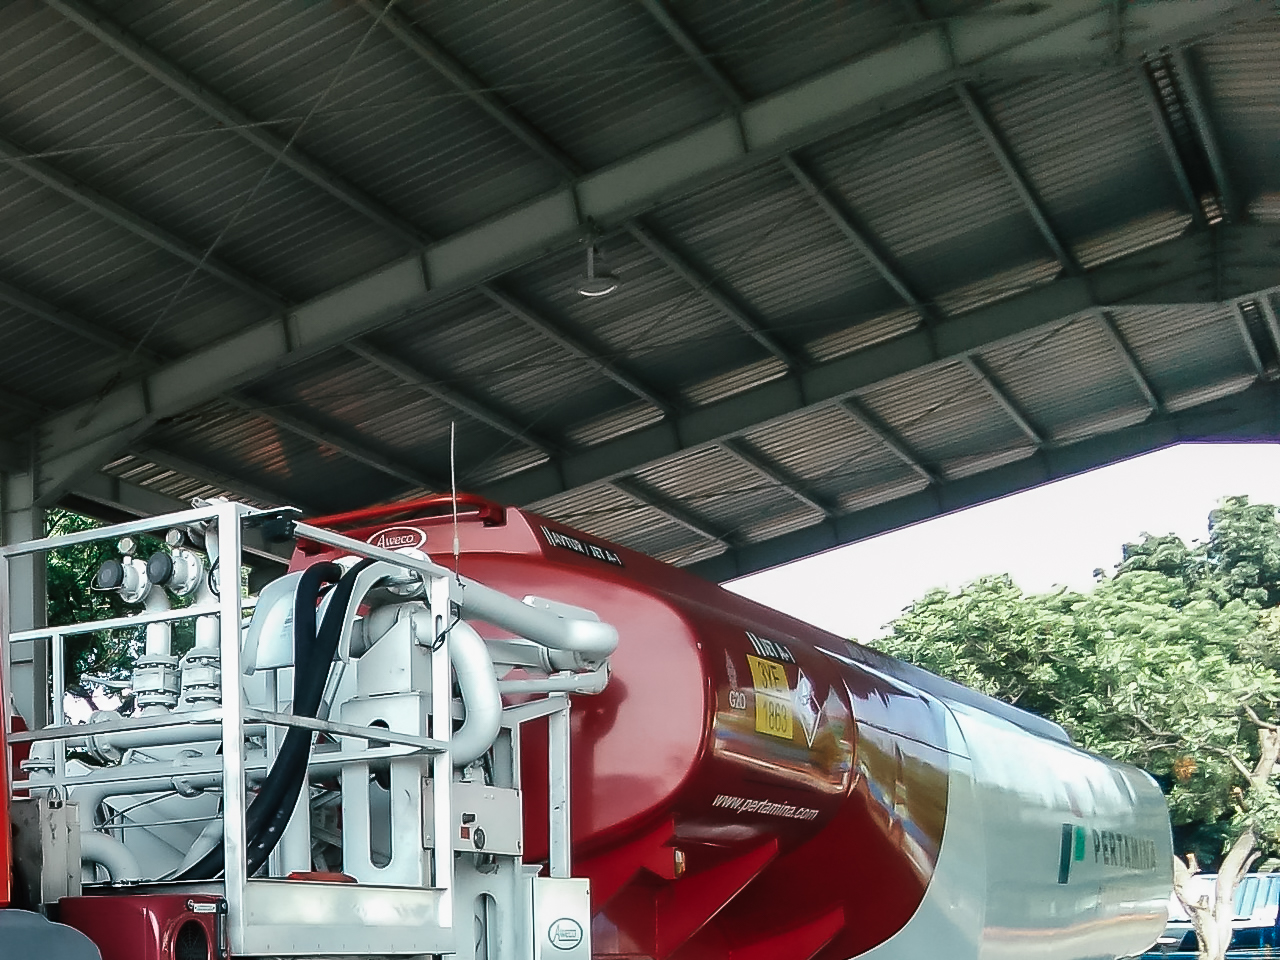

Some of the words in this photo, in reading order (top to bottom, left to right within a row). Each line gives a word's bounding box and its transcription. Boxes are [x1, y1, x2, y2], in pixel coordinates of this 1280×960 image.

[551, 531, 585, 554] AVTUR
[762, 700, 787, 733] 1863
[712, 794, 819, 820] www.pertamina.com
